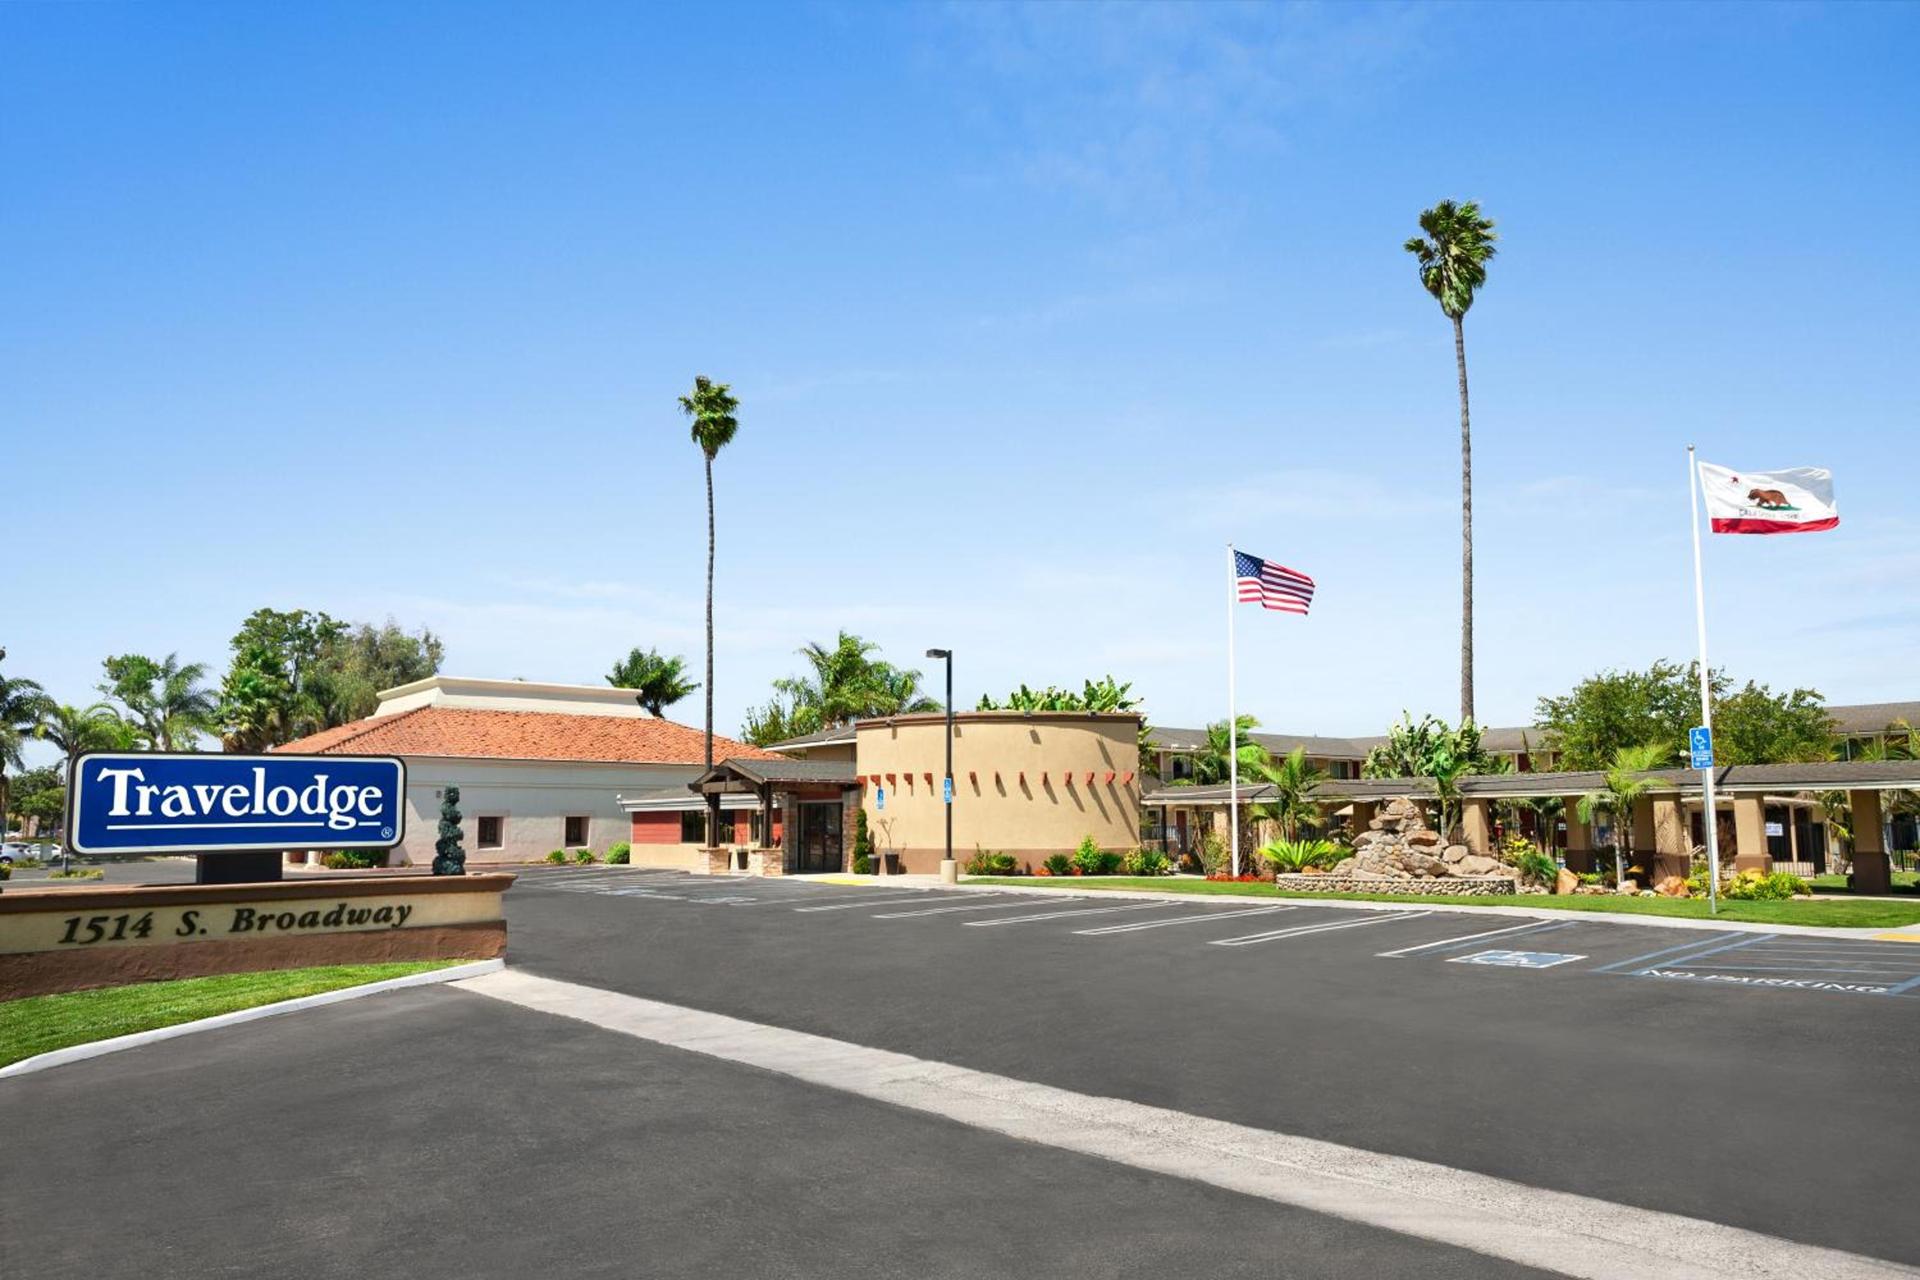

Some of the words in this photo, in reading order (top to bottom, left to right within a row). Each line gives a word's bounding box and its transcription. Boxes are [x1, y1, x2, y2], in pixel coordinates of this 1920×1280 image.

[96, 767, 383, 831] Travelodge
[58, 911, 154, 945] 1514
[175, 910, 208, 938] S.
[229, 902, 412, 934] Broadway
[1640, 969, 1696, 978] NO
[1703, 974, 1888, 993] PARKING
